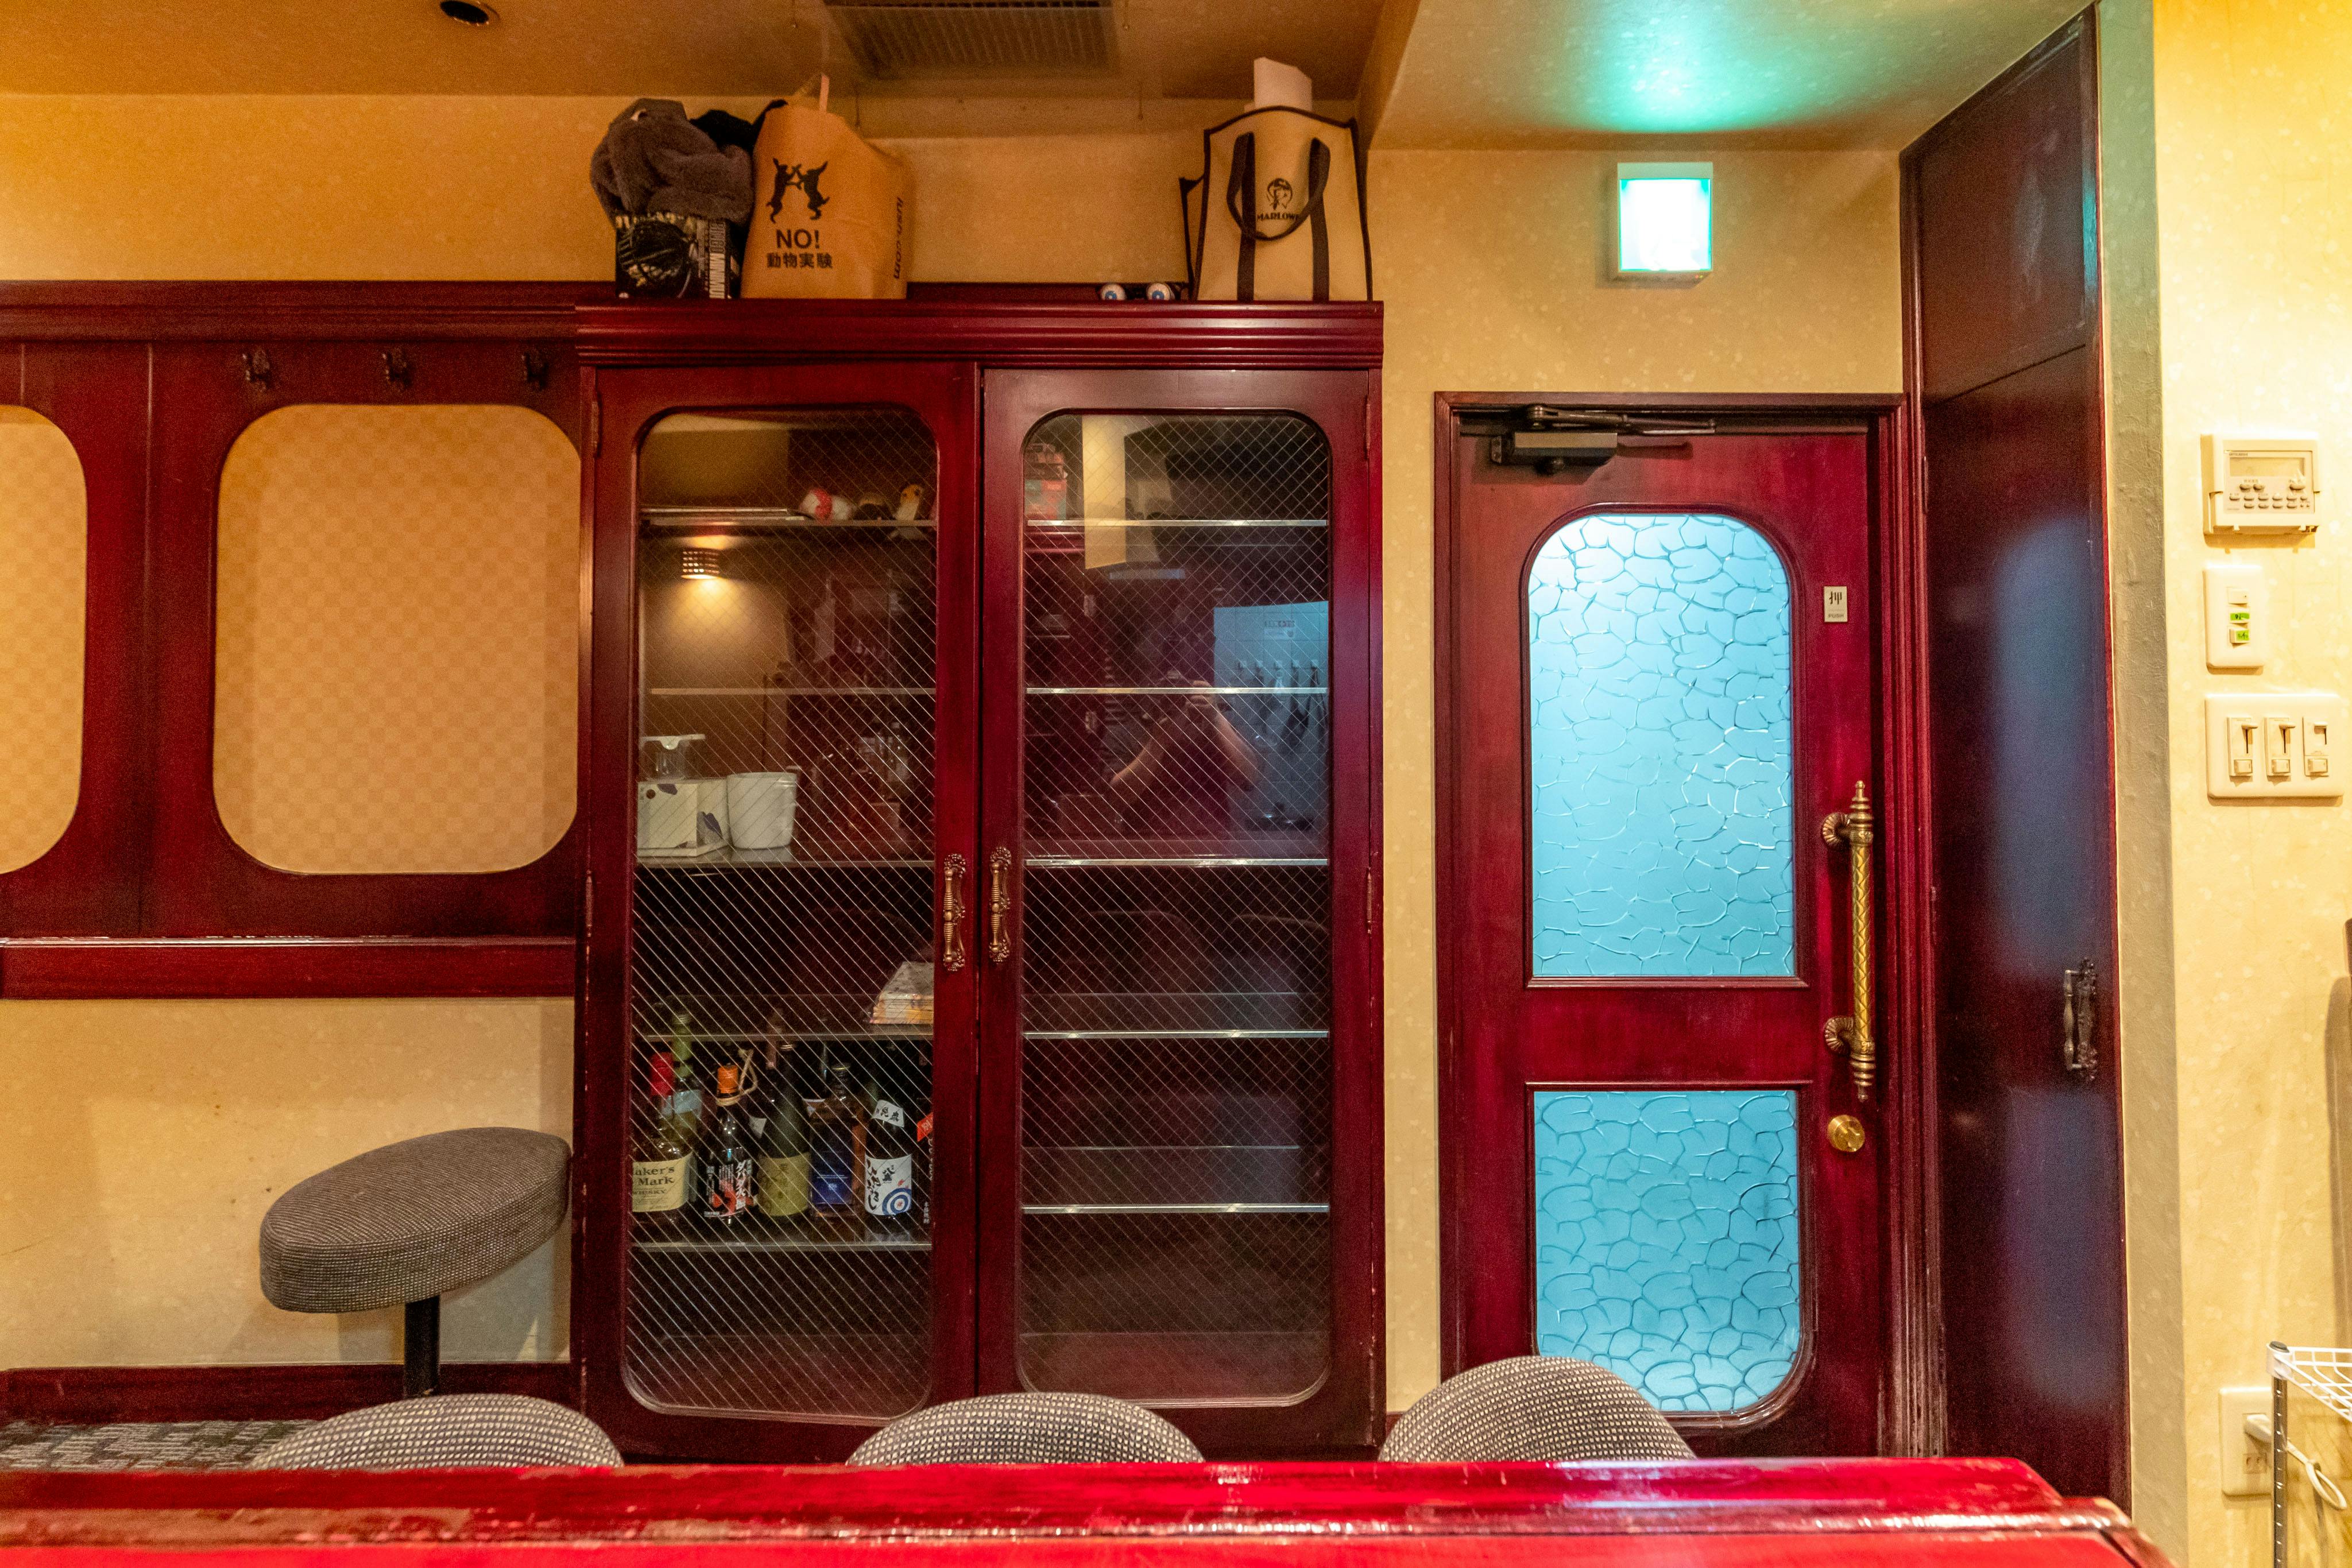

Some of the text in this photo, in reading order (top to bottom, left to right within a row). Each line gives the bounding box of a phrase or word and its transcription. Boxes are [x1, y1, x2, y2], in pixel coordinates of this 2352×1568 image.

[776, 229, 820, 249] NO!
[767, 253, 834, 269] 動物実験
[1829, 591, 1842, 605] 押
[633, 1166, 675, 1176] aker's
[637, 1176, 675, 1186] Mark
